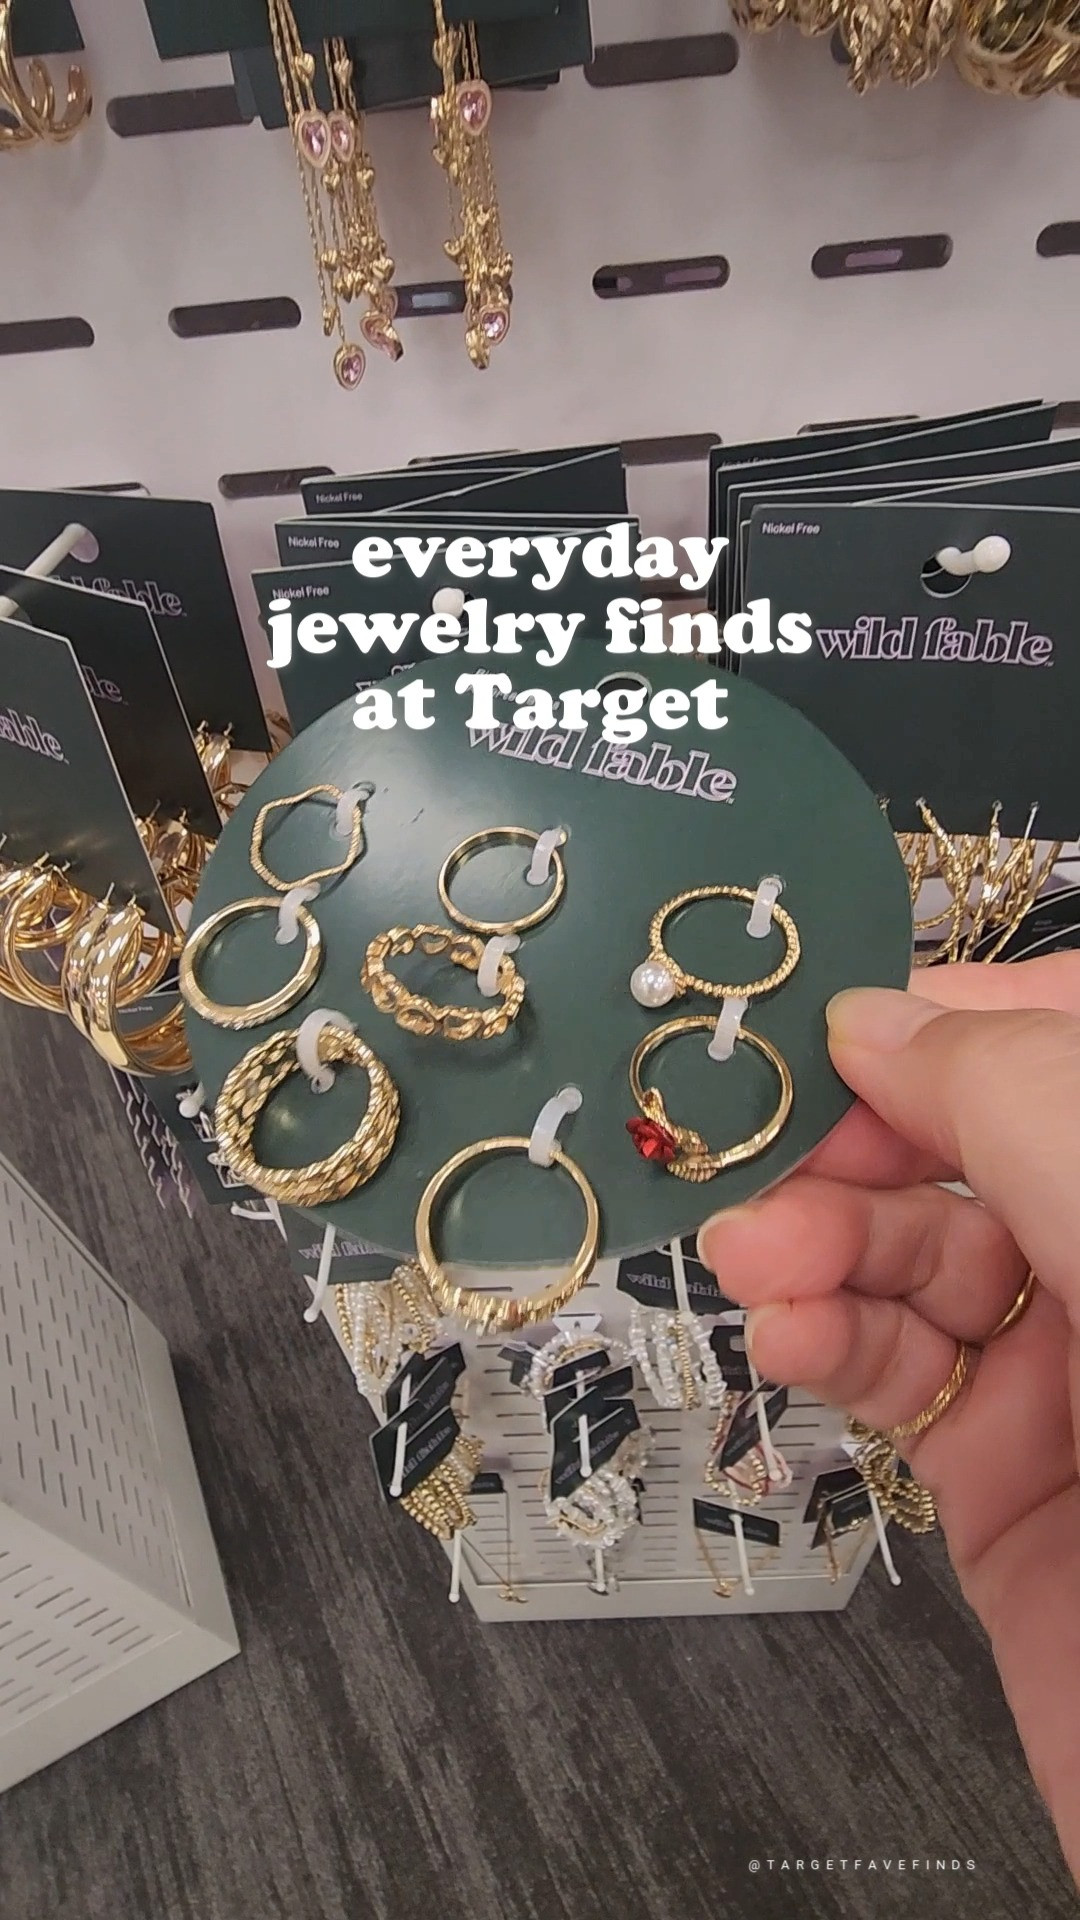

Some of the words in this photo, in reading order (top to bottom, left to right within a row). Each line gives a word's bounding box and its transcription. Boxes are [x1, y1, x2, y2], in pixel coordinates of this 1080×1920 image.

[761, 522, 794, 534] Nickel
[795, 522, 820, 534] Free
[287, 536, 317, 548] Nickel
[318, 536, 340, 549] Free
[272, 587, 305, 600] Nickel
[305, 585, 330, 597] Free
[815, 616, 919, 660] wild
[921, 616, 1054, 667] fable
[468, 723, 588, 770] wild
